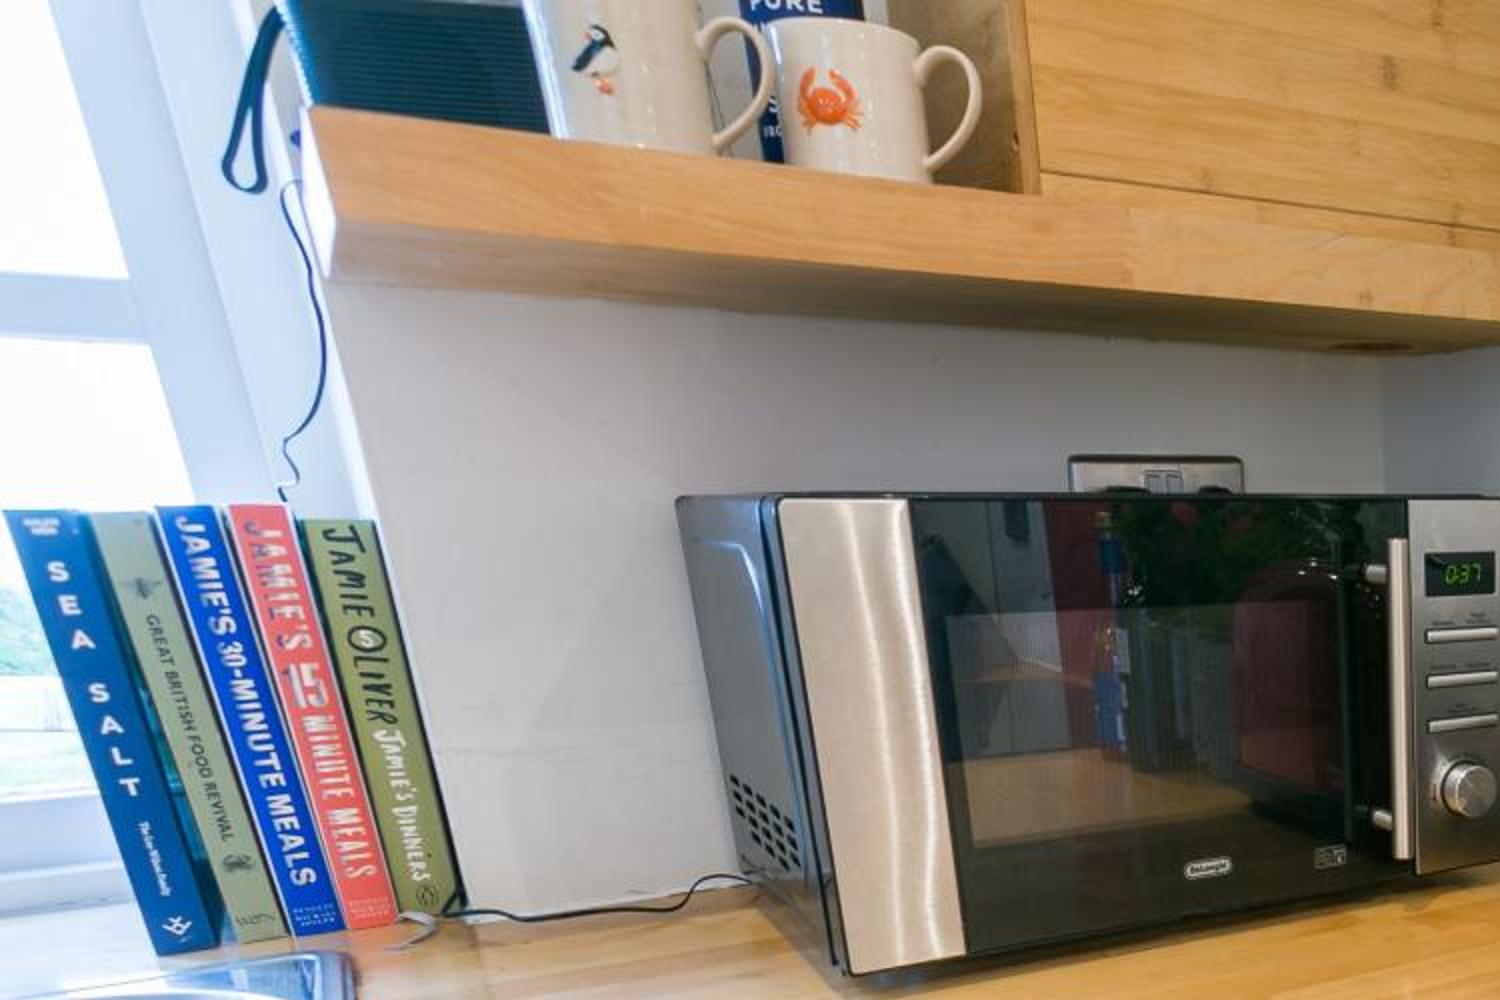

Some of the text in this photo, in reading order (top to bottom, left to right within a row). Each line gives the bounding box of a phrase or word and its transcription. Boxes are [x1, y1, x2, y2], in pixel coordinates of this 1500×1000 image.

[244, 522, 313, 650] JAMIE'S
[322, 524, 400, 726] JAMIE OLIVER
[47, 560, 140, 796] SEA SALT
[146, 614, 235, 842] GREAT BRITISH FOOD REVIVAL
[176, 515, 237, 636] JAMIE'S
[217, 641, 287, 788] 30-MINUTE
[266, 793, 317, 886] MEALS
[303, 714, 354, 799] MINUTE
[328, 808, 377, 879] MEALS
[372, 729, 432, 881] JAMIE'S DINNERS
